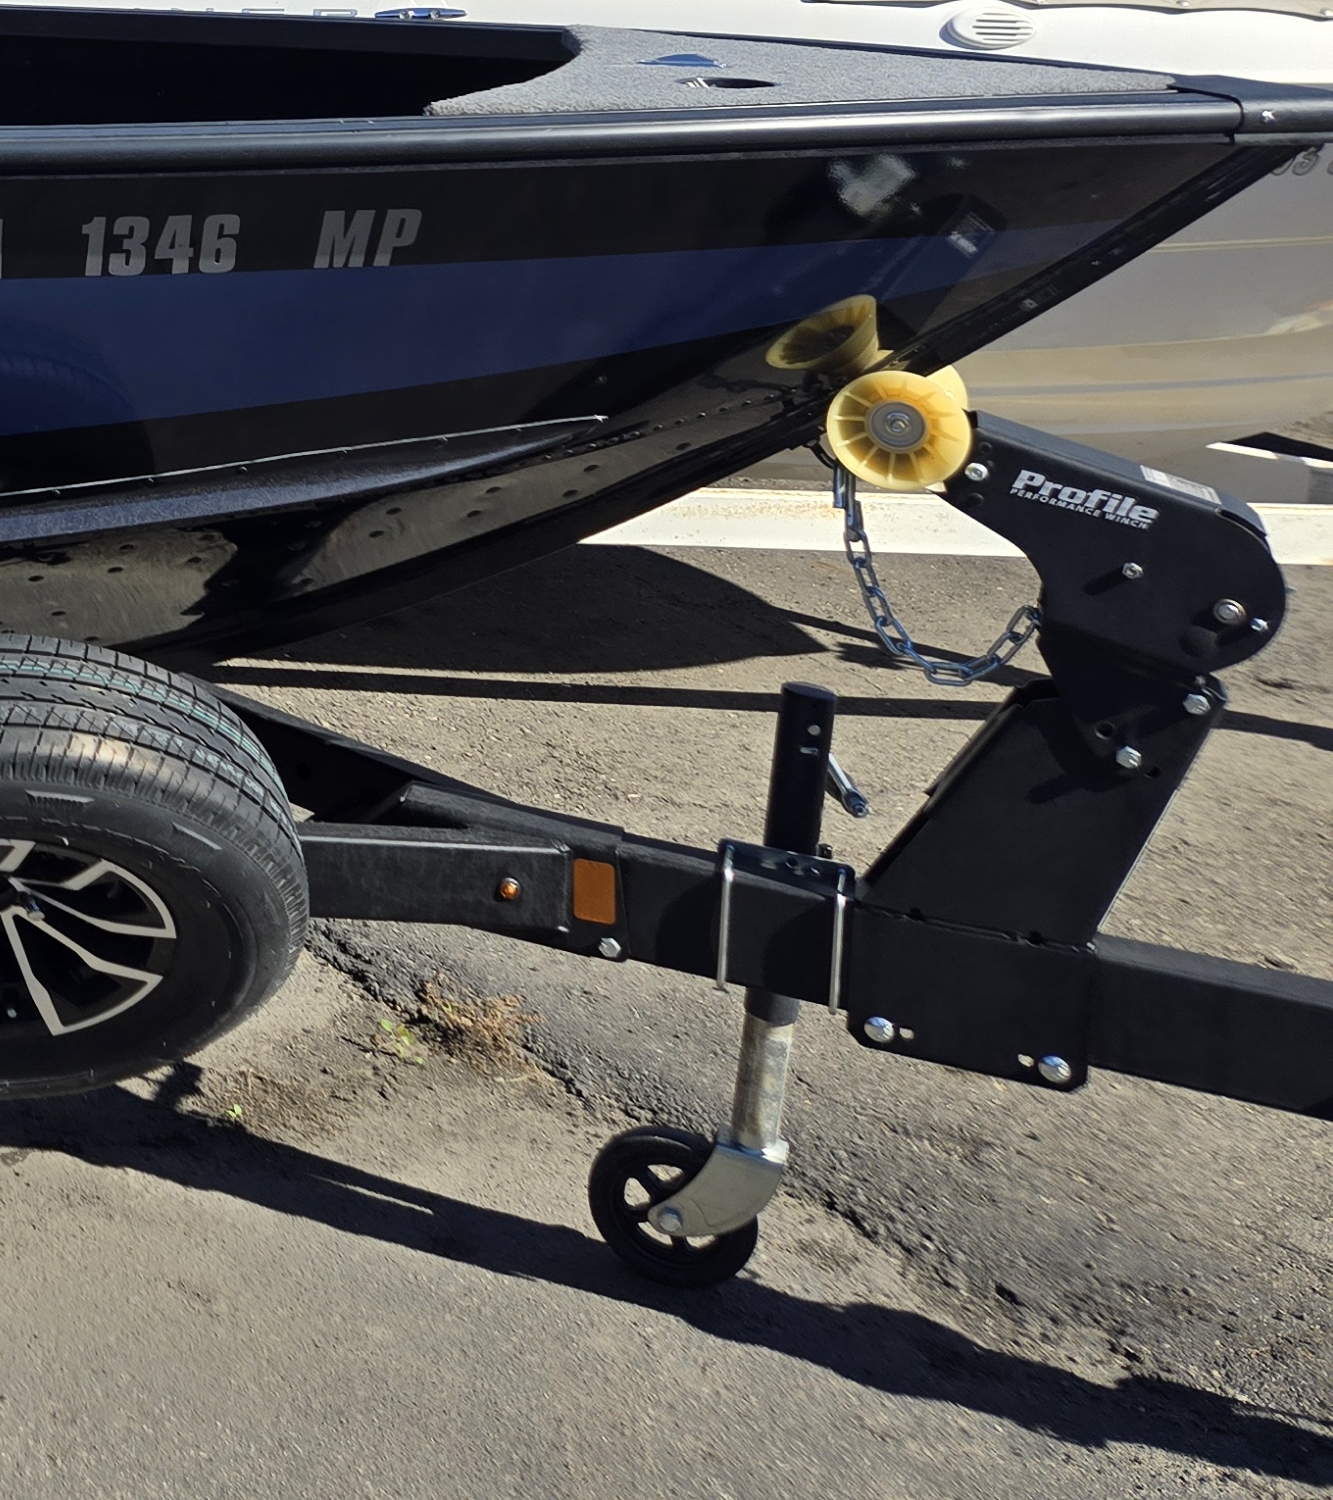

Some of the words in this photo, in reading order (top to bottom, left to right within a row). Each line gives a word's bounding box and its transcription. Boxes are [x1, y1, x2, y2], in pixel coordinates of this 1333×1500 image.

[82, 213, 240, 277] 1346
[313, 209, 422, 268] MP
[1010, 488, 1101, 518] PERFORMANCE
[1104, 512, 1150, 530] WINCH
[1012, 469, 1160, 523] Profile
